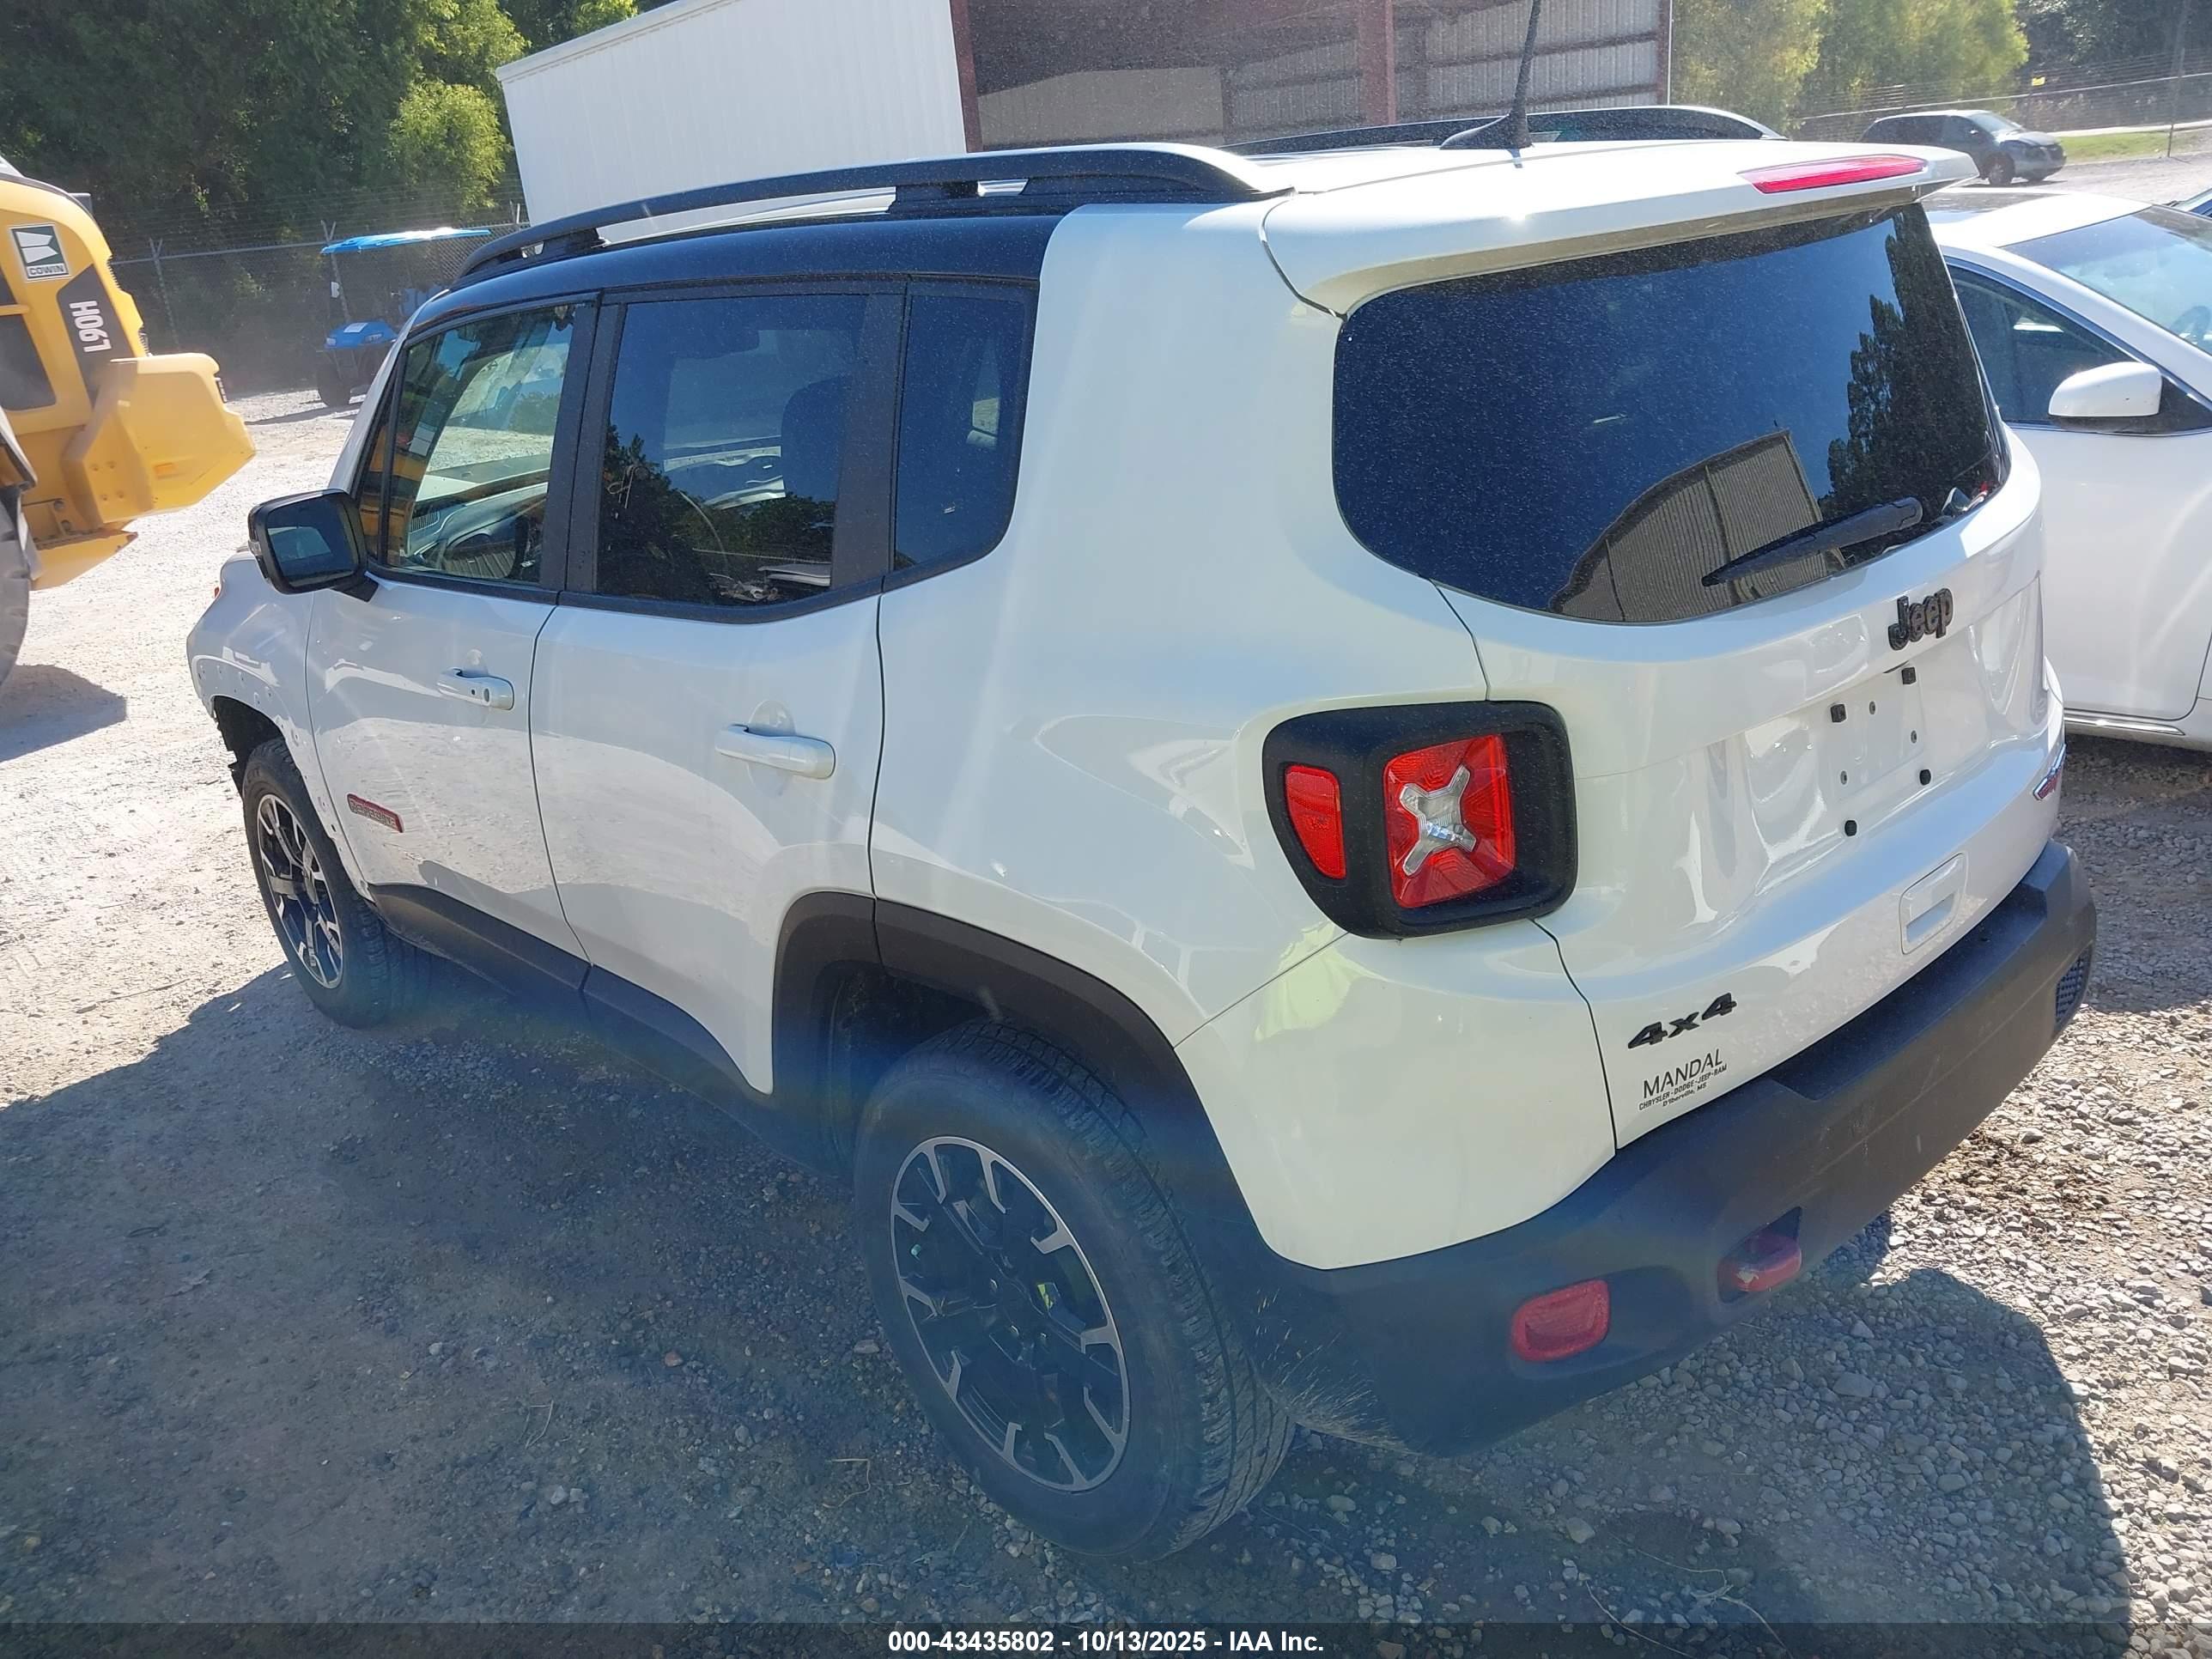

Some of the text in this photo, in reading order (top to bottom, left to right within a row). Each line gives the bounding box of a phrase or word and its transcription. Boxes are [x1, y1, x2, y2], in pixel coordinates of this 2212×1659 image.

[28, 264, 65, 276] COWIN
[69, 301, 112, 353] L90H
[1887, 587, 1954, 651] Jeep
[1627, 993, 1737, 1049] 4x4
[1643, 1048, 1723, 1099] MANDAL
